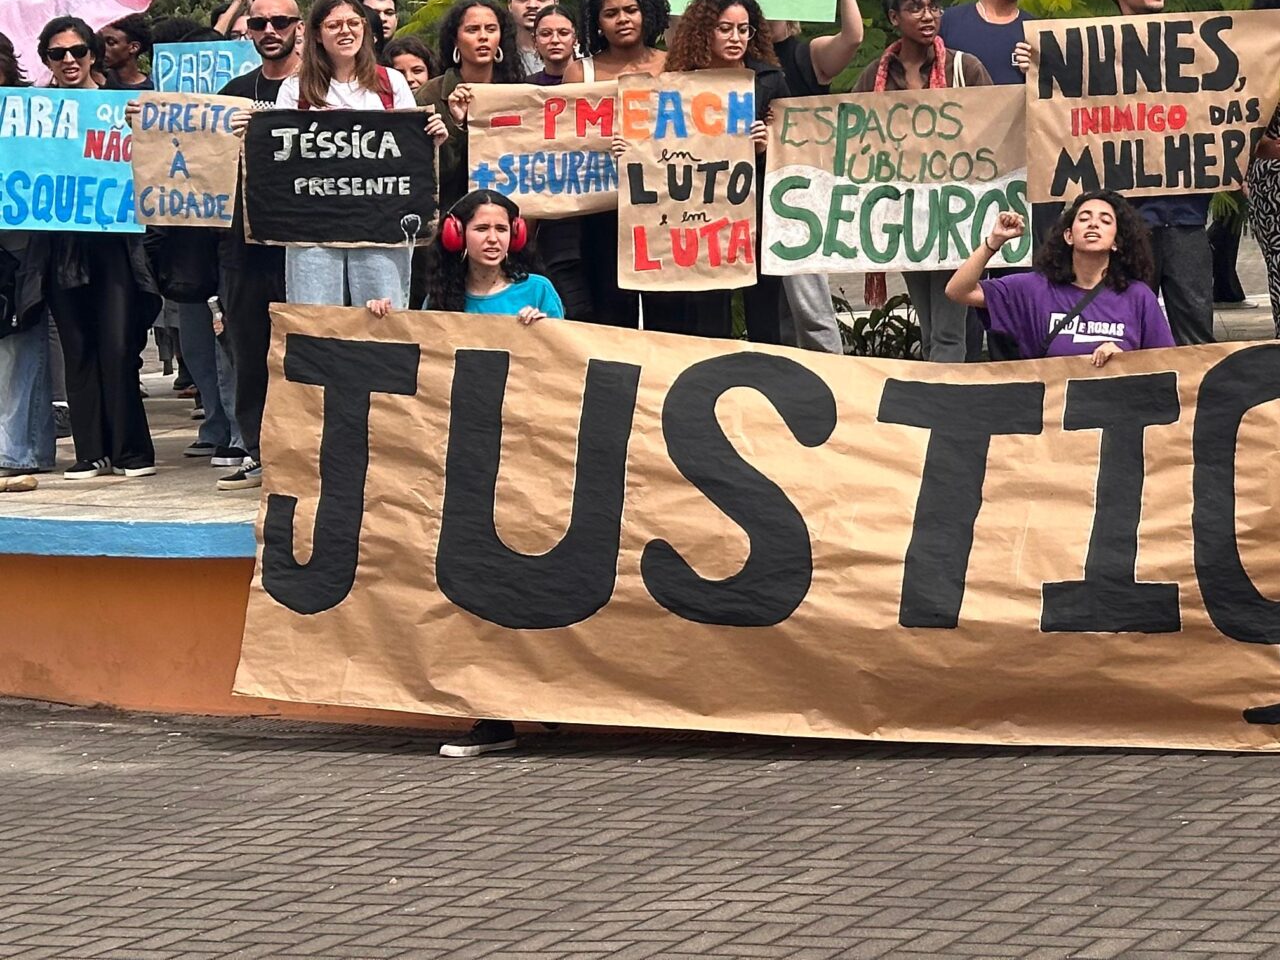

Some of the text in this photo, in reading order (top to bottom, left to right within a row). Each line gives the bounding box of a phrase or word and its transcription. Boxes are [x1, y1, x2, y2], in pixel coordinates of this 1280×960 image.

[153, 50, 234, 93] PARA
[1038, 16, 1247, 100] NUNES,
[0, 95, 127, 139] ARA QU
[543, 96, 615, 140] PM
[622, 89, 753, 140] EACH
[1071, 97, 1260, 136] INIMIGO DAS
[656, 148, 702, 164] em
[0, 169, 138, 230] SQUEÇA
[294, 176, 411, 197] PRESENTE
[627, 160, 754, 205] LUTO
[680, 210, 711, 223] em
[769, 175, 1031, 264] SEGUROS
[632, 216, 753, 272] LUTA
[1087, 320, 1125, 337] ROSAS
